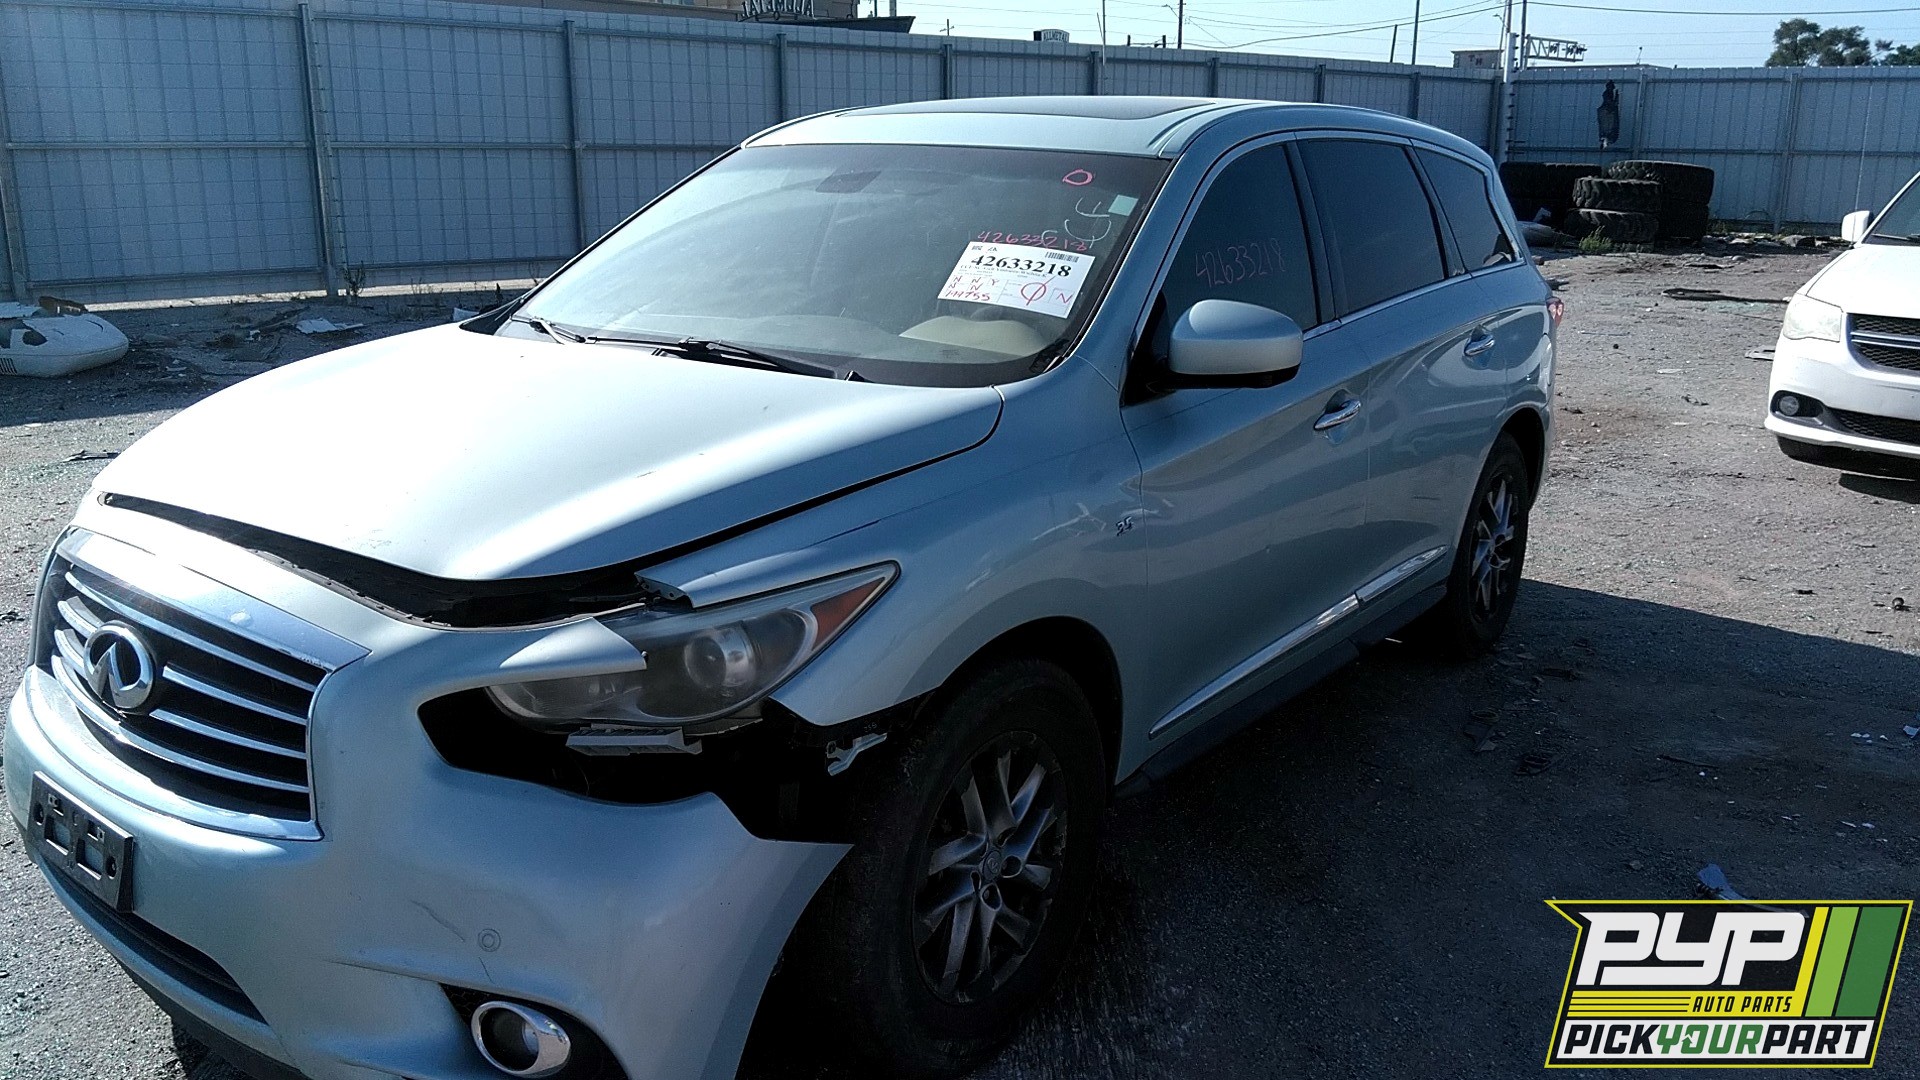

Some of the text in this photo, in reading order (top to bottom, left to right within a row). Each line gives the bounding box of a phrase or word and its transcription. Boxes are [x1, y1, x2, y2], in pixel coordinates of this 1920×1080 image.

[977, 230, 1088, 252] 42633218
[971, 254, 1072, 278] 42633218
[1195, 238, 1286, 288] 42633218
